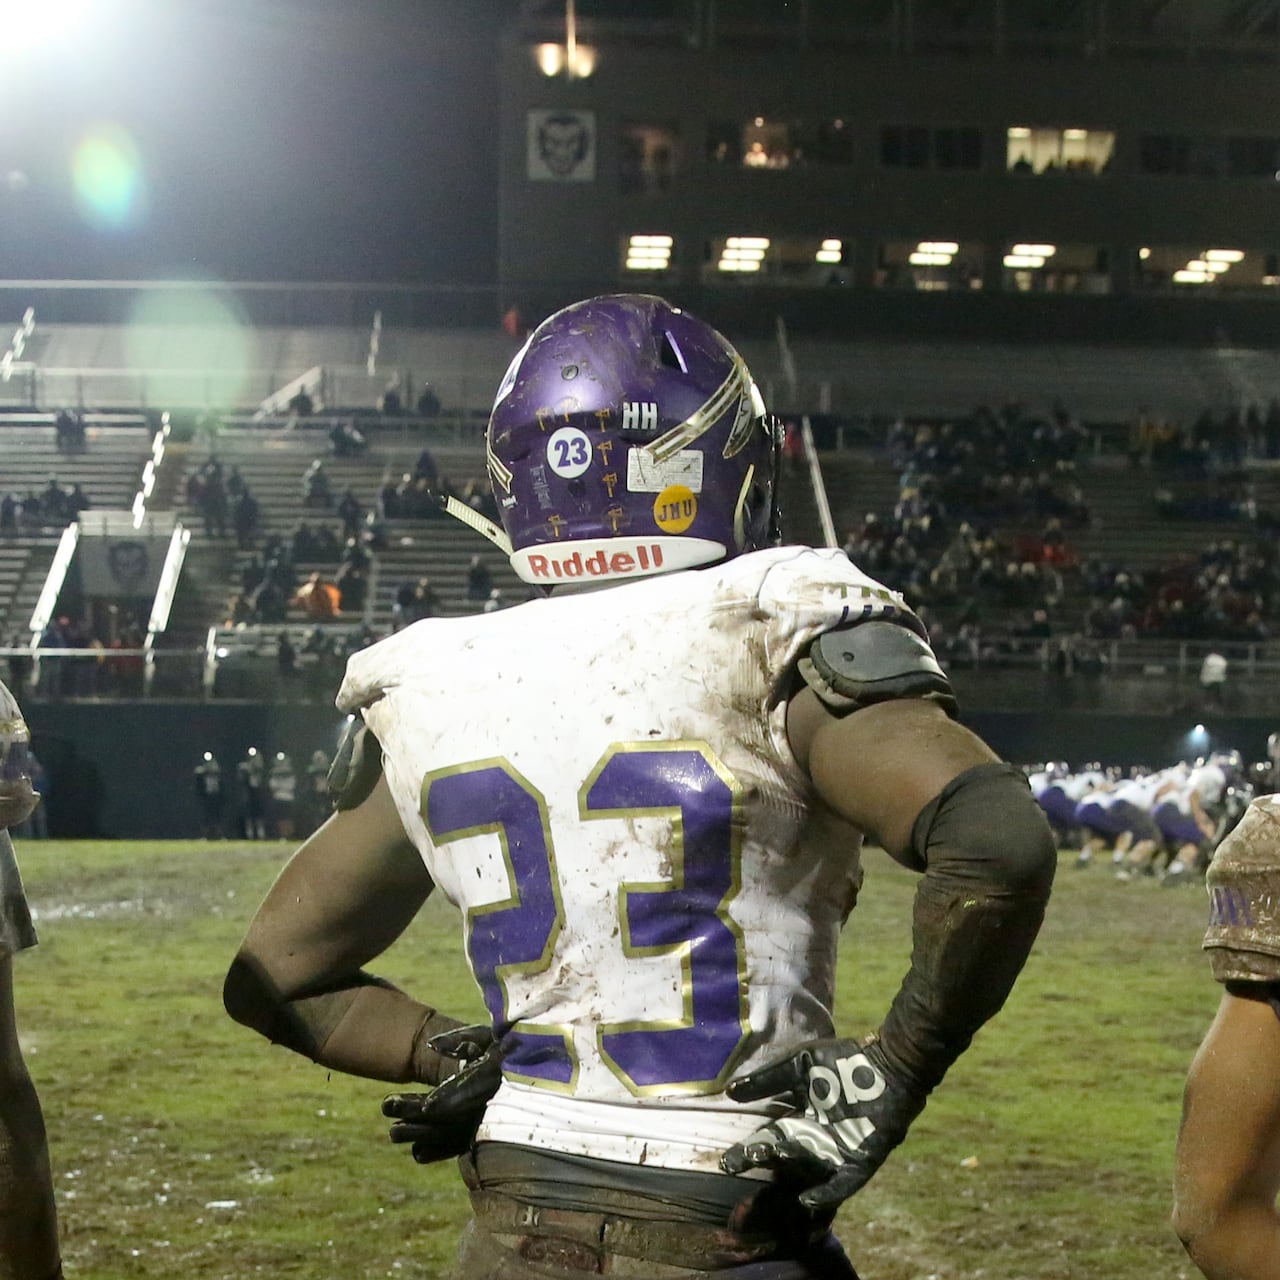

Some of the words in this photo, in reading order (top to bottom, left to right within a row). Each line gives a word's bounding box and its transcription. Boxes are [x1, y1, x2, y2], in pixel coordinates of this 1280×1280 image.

[622, 402, 658, 430] HH
[554, 437, 589, 468] 23
[658, 498, 693, 522] JMU
[527, 544, 664, 578] Riddell
[419, 740, 753, 1098] 23
